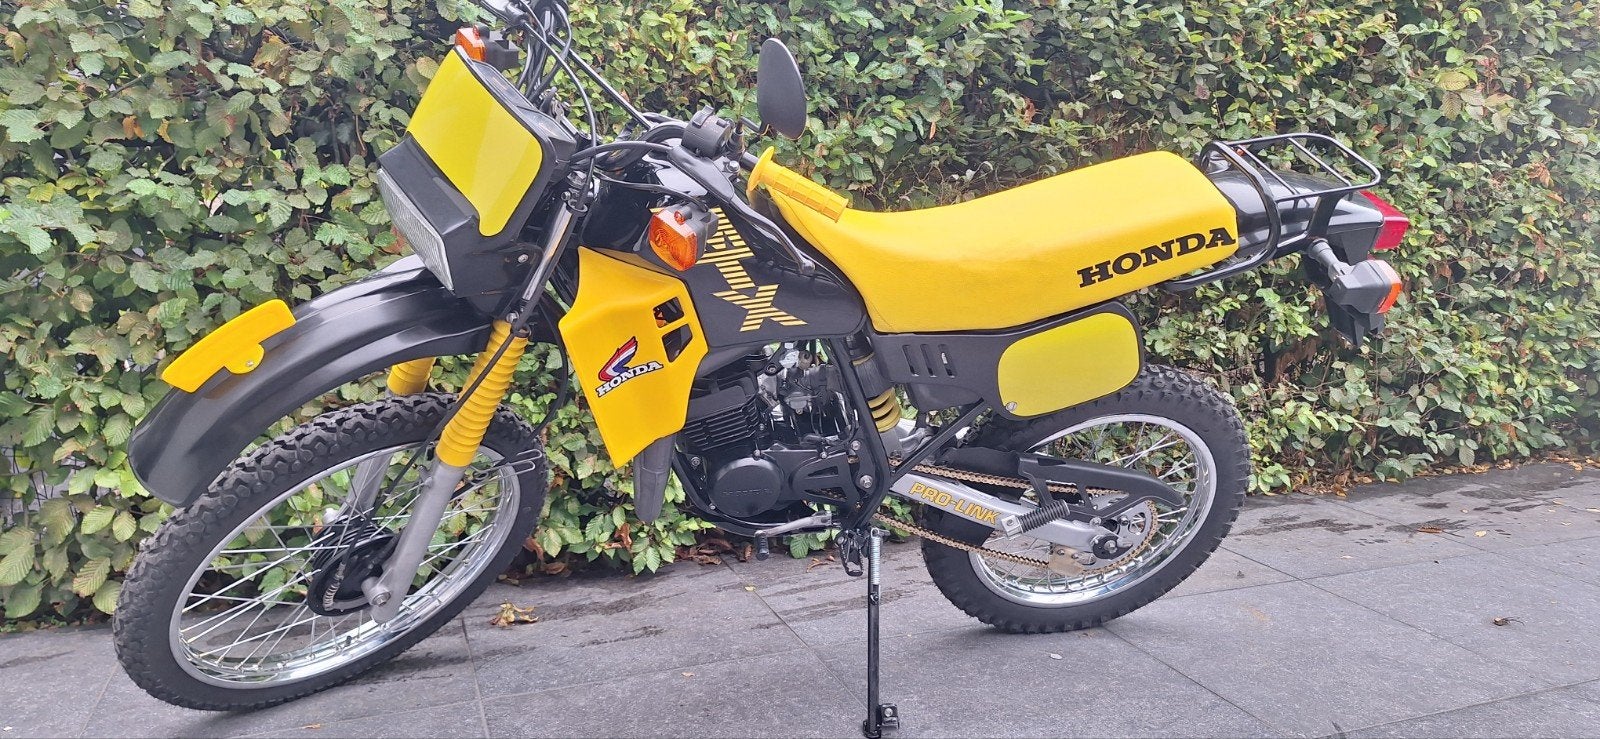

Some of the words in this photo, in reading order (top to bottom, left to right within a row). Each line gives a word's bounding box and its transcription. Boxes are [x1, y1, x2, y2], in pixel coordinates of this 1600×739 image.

[1077, 227, 1236, 288] HONDA
[595, 361, 664, 398] HONDA
[909, 482, 1001, 525] PRO-LINK
